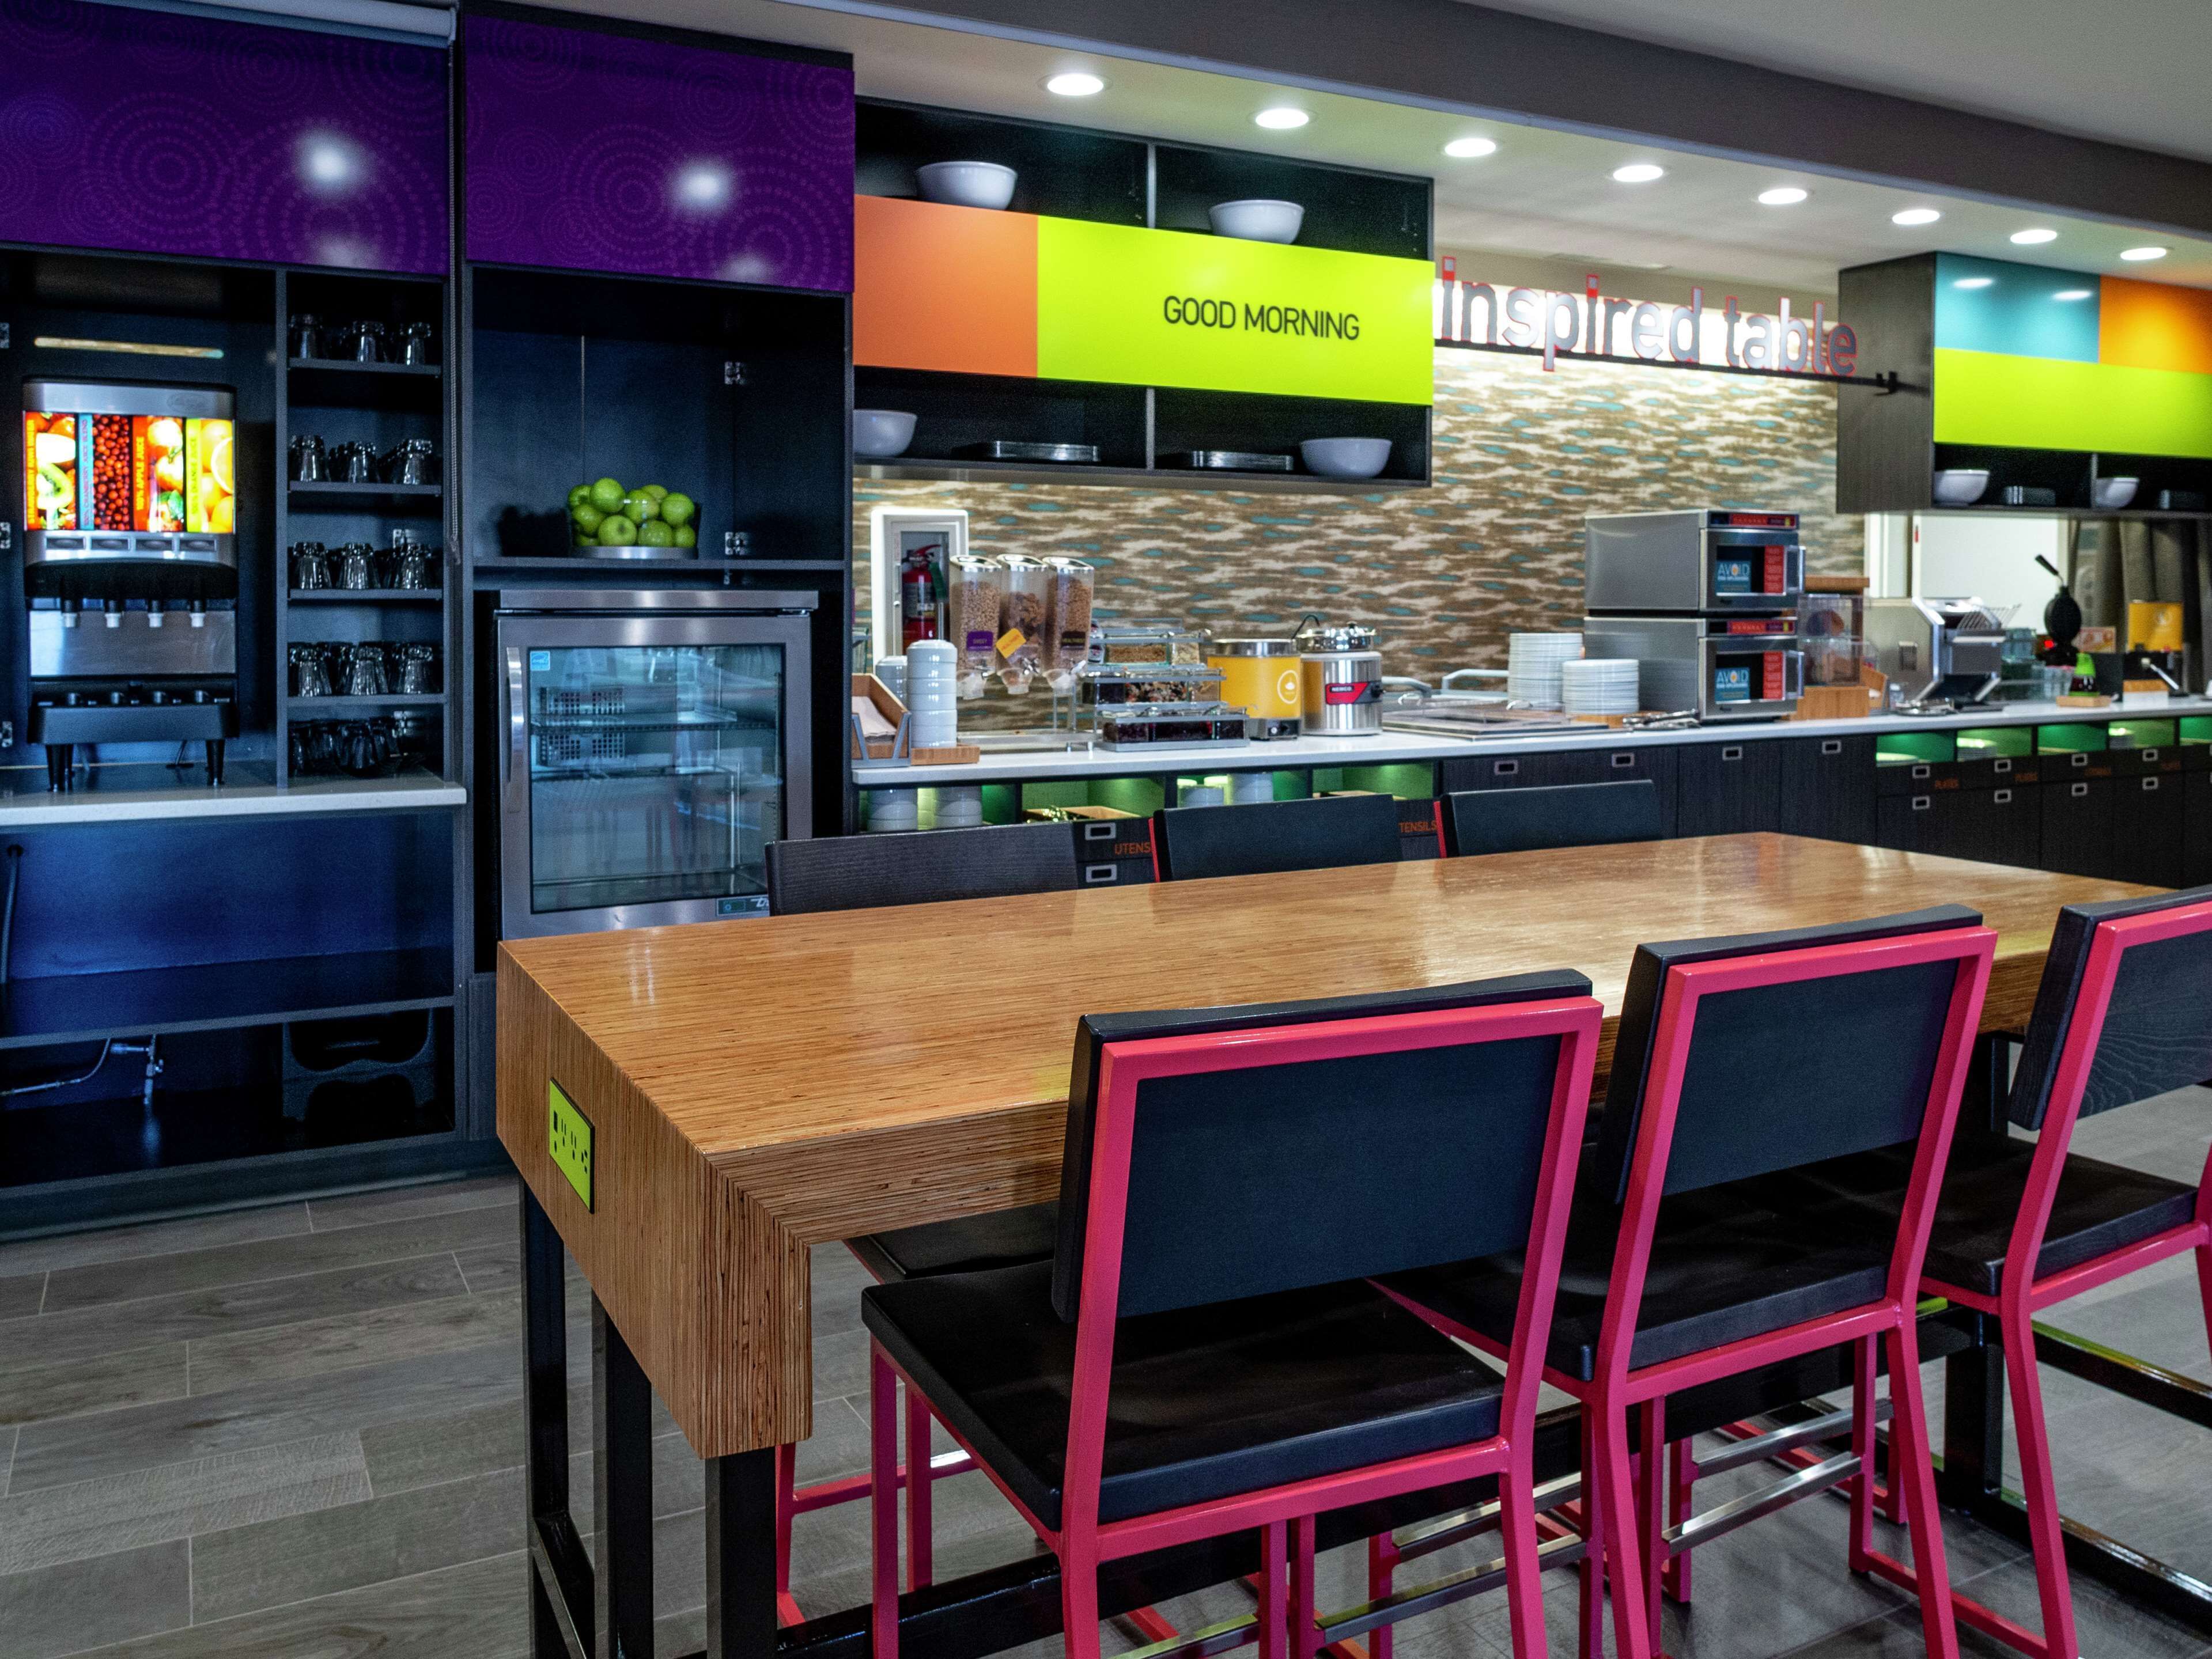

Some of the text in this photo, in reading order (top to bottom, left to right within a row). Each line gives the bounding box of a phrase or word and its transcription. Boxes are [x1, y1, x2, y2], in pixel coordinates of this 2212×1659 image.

[1163, 295, 1360, 340] GOOD MORNING
[1441, 256, 1858, 376] inspired table
[136, 435, 145, 510] 100% APPLE JUICE
